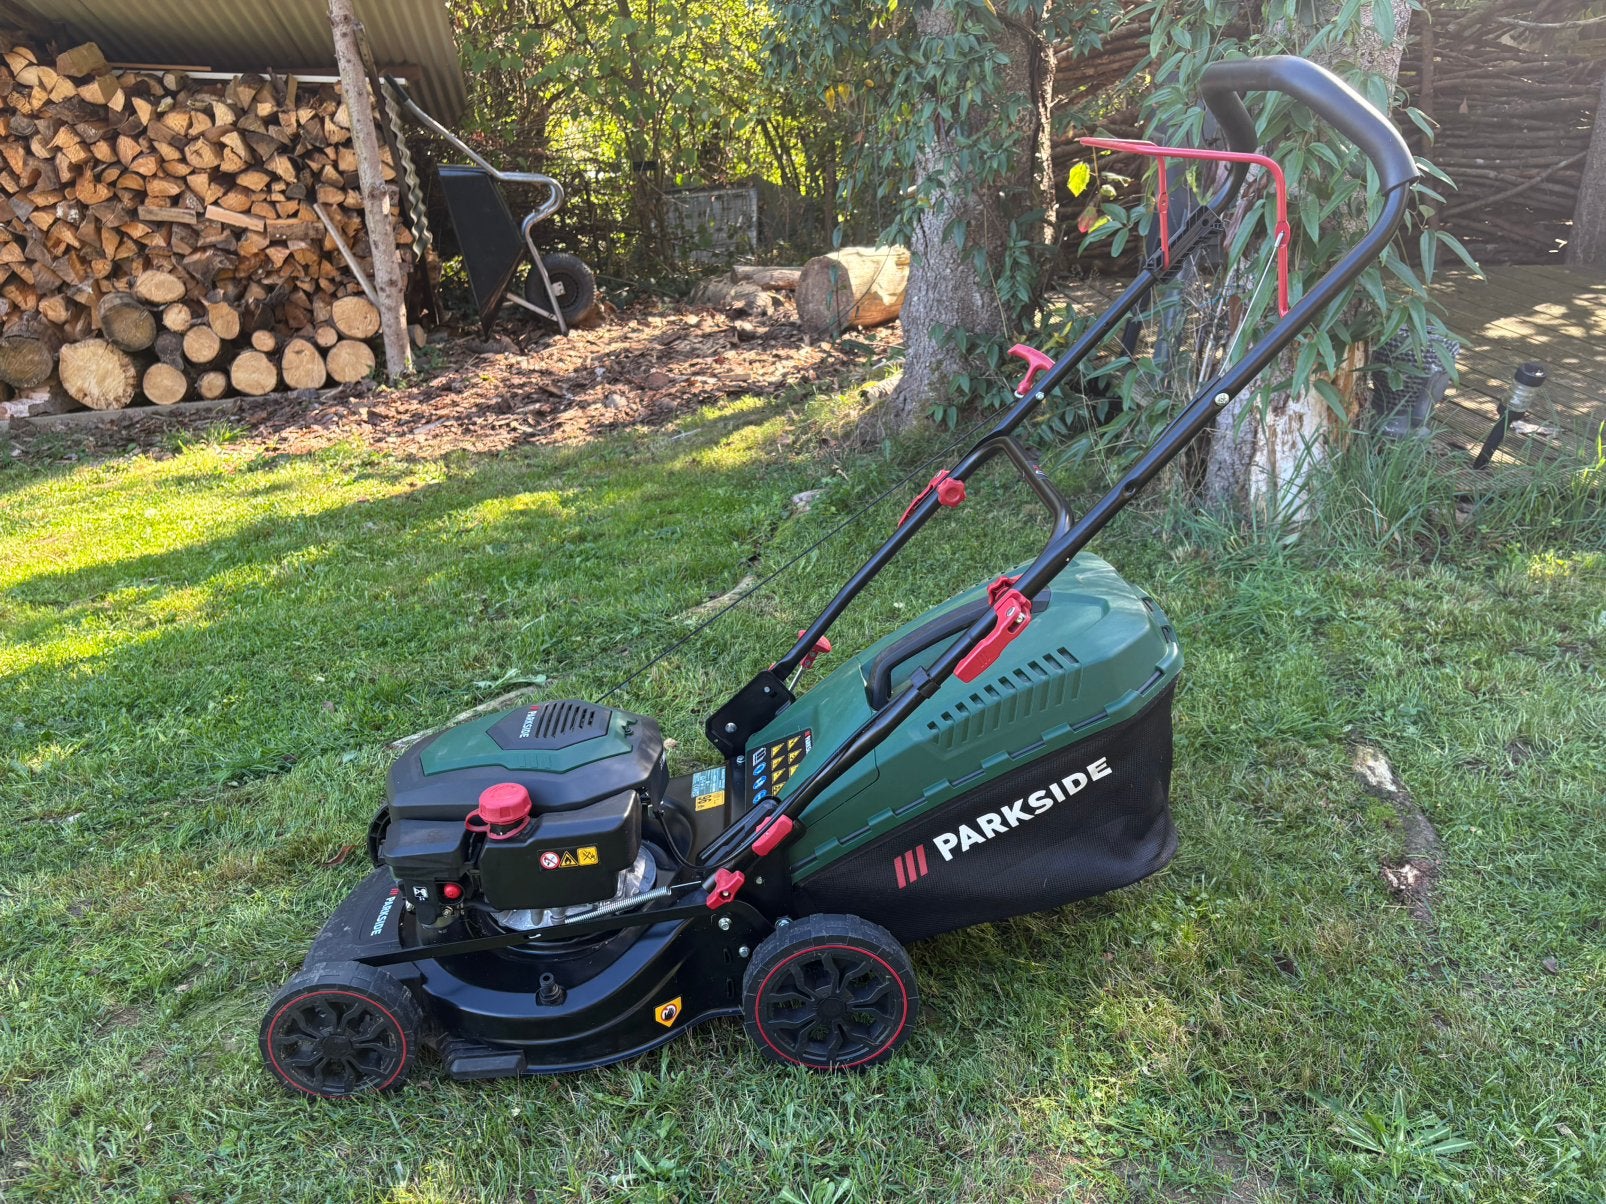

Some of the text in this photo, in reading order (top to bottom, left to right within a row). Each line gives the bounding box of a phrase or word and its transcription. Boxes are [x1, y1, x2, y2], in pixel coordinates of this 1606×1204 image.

[519, 710, 537, 738] PARKSIDE
[932, 756, 1113, 862] PARKSIDE
[370, 896, 396, 936] PARKSIDE
